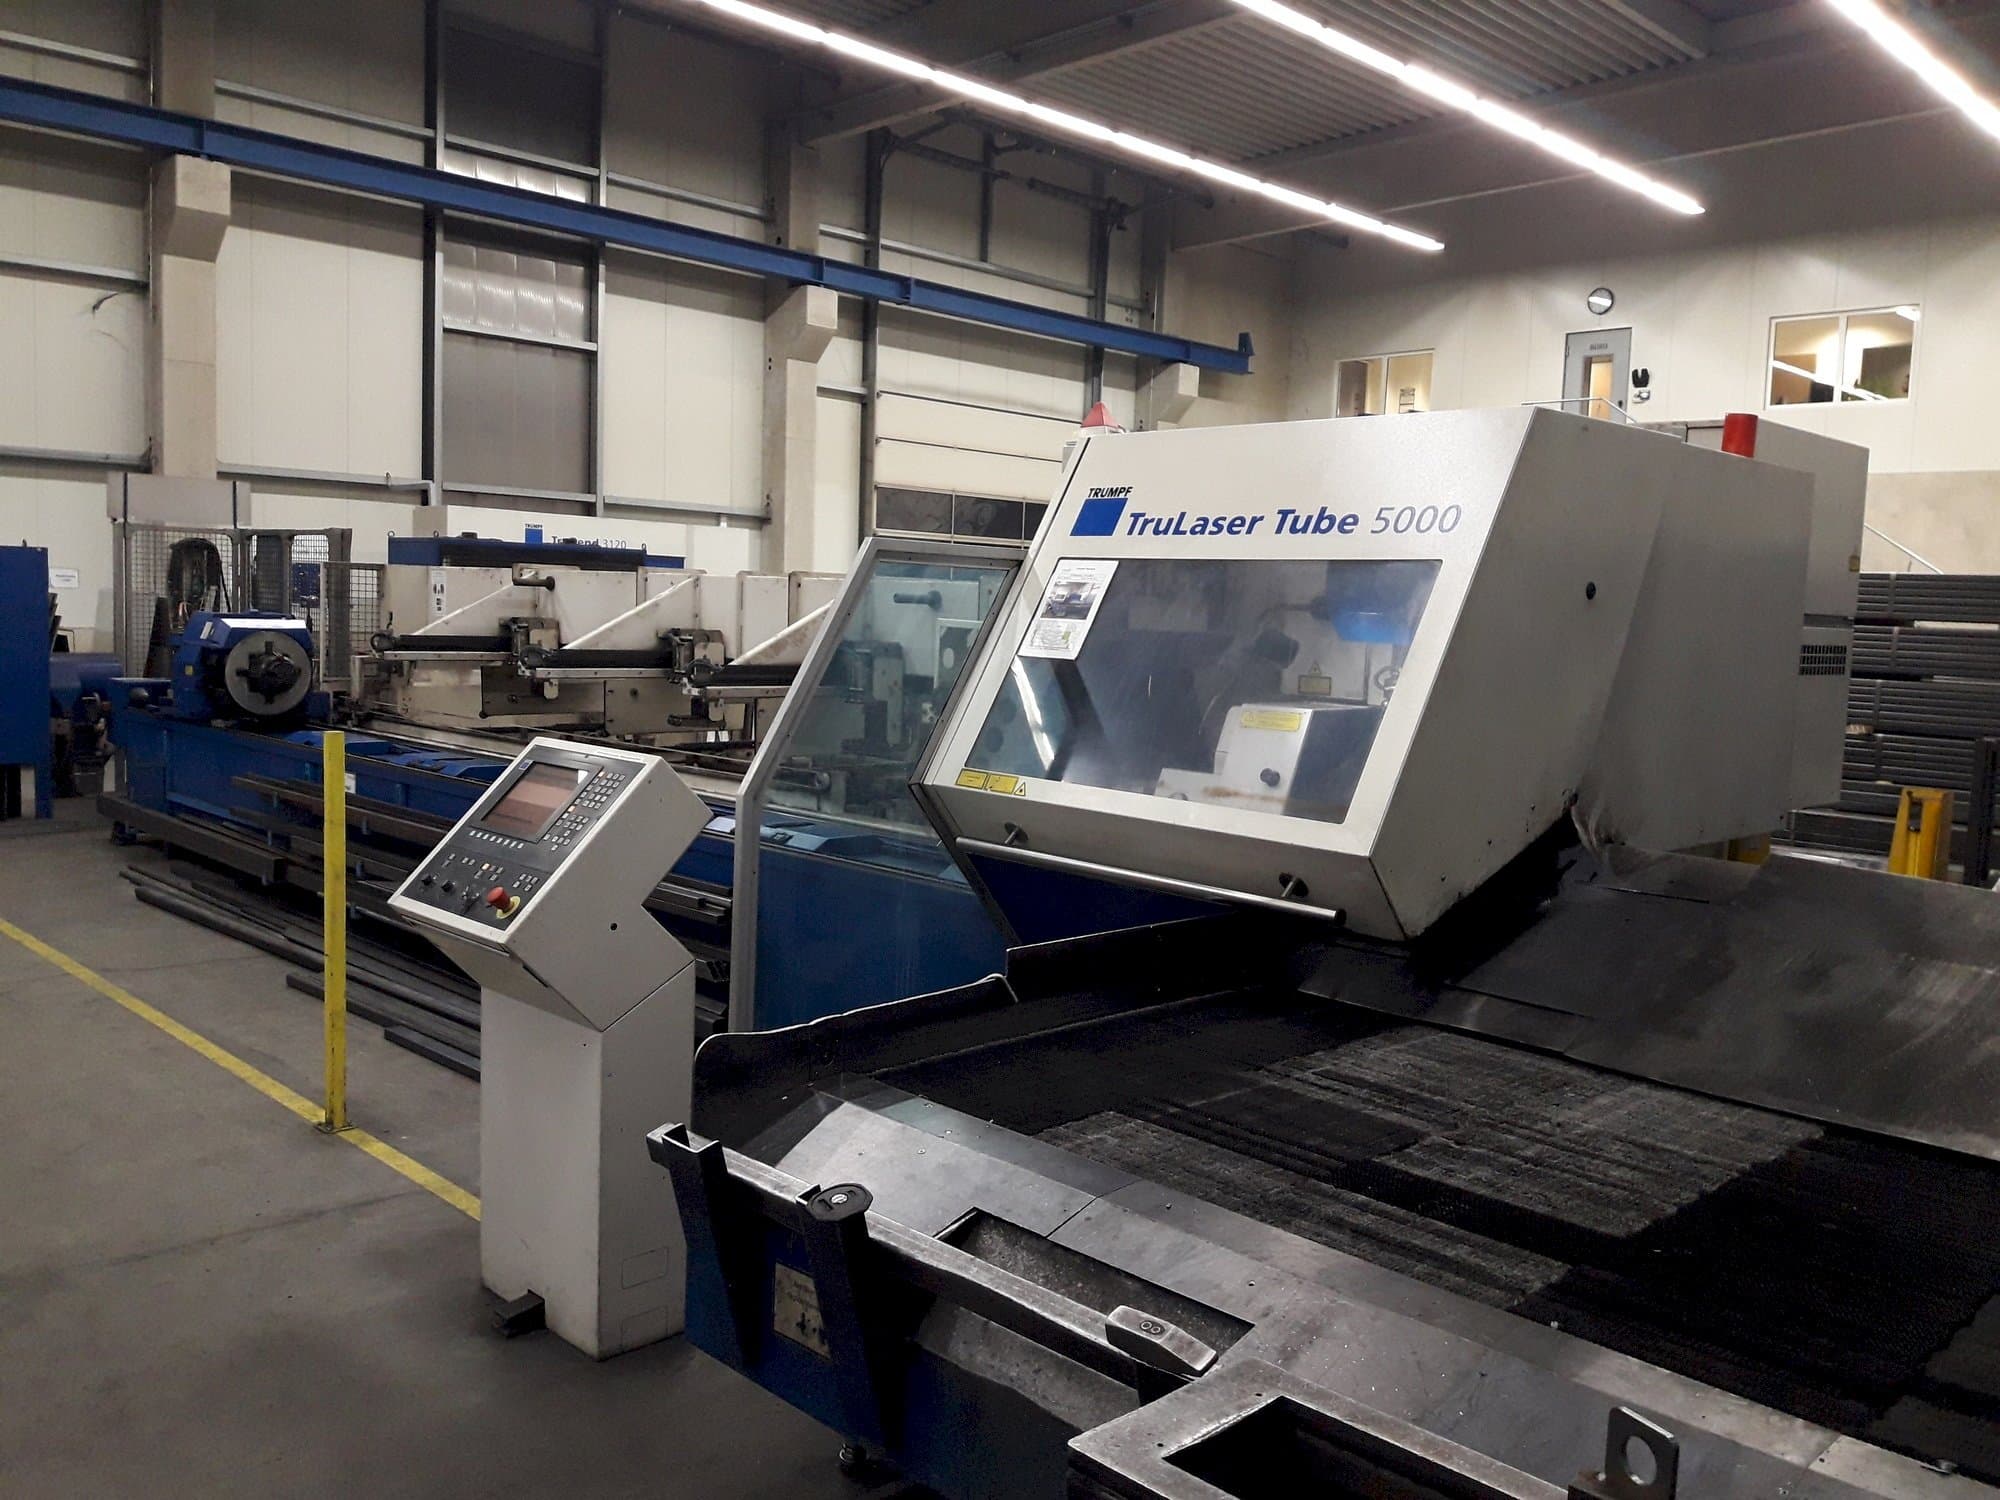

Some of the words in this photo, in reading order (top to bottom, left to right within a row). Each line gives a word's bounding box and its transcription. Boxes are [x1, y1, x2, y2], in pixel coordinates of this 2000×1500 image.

[1088, 486, 1133, 498] TRUMPF
[1126, 512, 1265, 536] TruLaser
[1274, 506, 1360, 535] Tube
[1370, 504, 1462, 534] 5000
[603, 538, 627, 549] 3120
